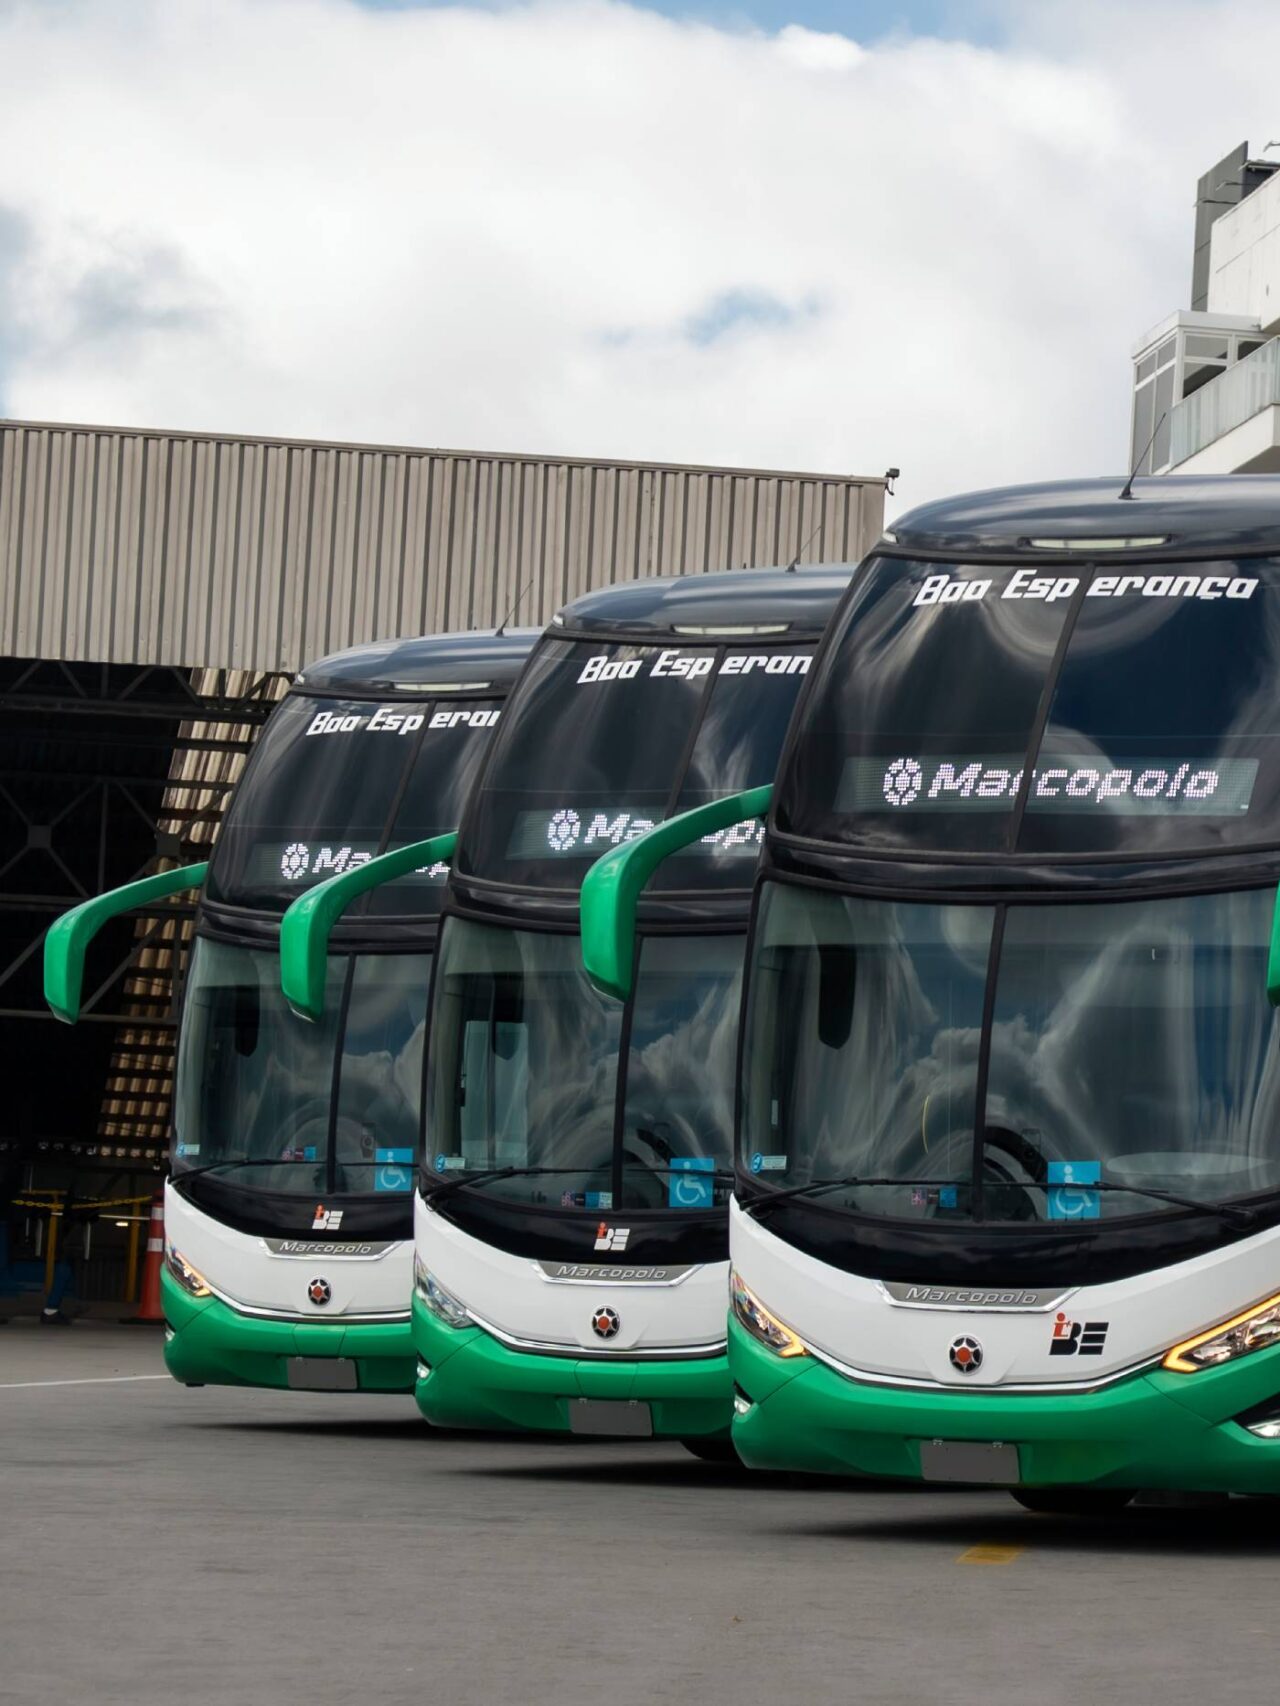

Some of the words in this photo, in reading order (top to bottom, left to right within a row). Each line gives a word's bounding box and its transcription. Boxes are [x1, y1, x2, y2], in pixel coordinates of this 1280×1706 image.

[912, 573, 993, 607] Boa
[576, 655, 644, 685] Boa
[649, 650, 815, 681] Esperan
[305, 711, 362, 736] Boa
[927, 762, 1220, 804] Marcopolo
[278, 1241, 373, 1255] Marcopolo
[555, 1264, 669, 1280] Marcopolo
[905, 1286, 1039, 1306] Marcopolo
